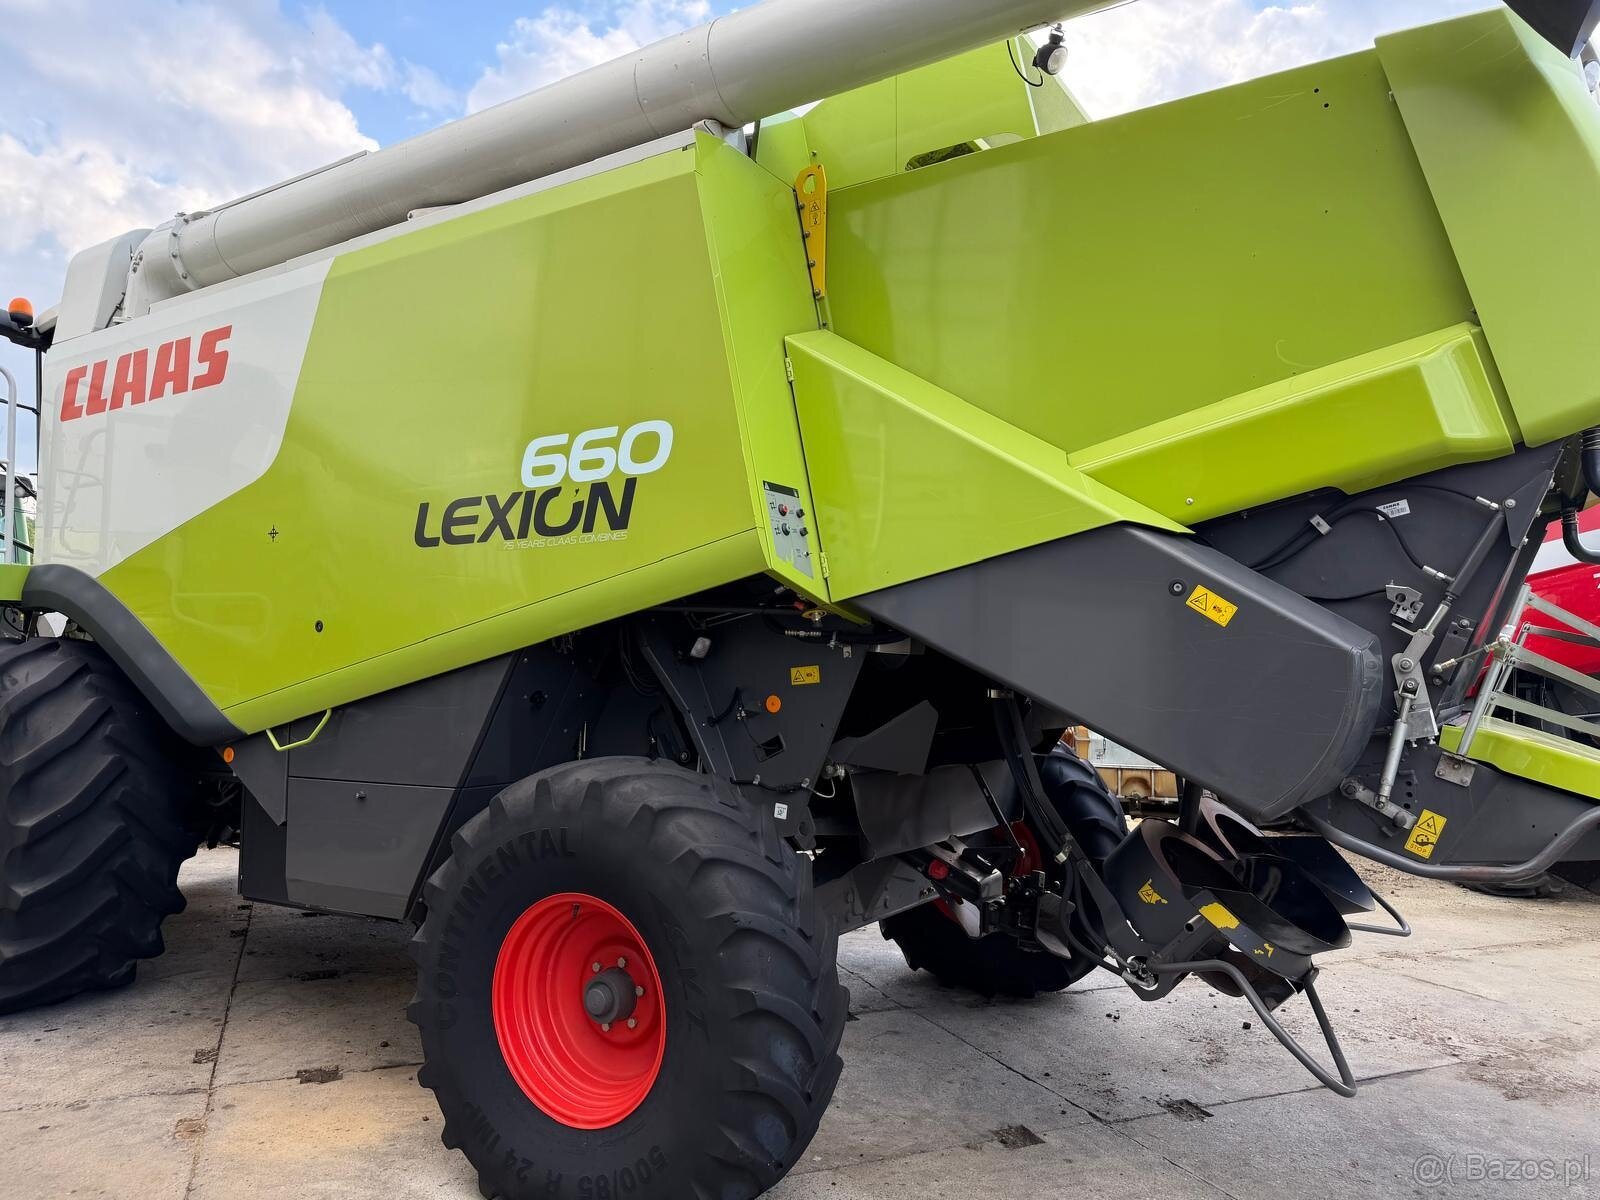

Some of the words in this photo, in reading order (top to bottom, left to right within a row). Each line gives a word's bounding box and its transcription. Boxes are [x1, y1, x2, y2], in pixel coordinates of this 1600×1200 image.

[60, 324, 233, 422] CLAAS
[520, 419, 674, 488] 660
[414, 476, 638, 548] LEXION
[503, 540, 515, 550] 75
[516, 538, 546, 549] YEARS
[547, 535, 577, 547] CLAAS
[579, 531, 629, 543] COMBINES
[1410, 843, 1427, 853] STOP
[436, 826, 577, 1031] CONTINENTAL
[505, 1148, 534, 1184] 24
[546, 1170, 563, 1194] R
[577, 1145, 668, 1200] 500/85
